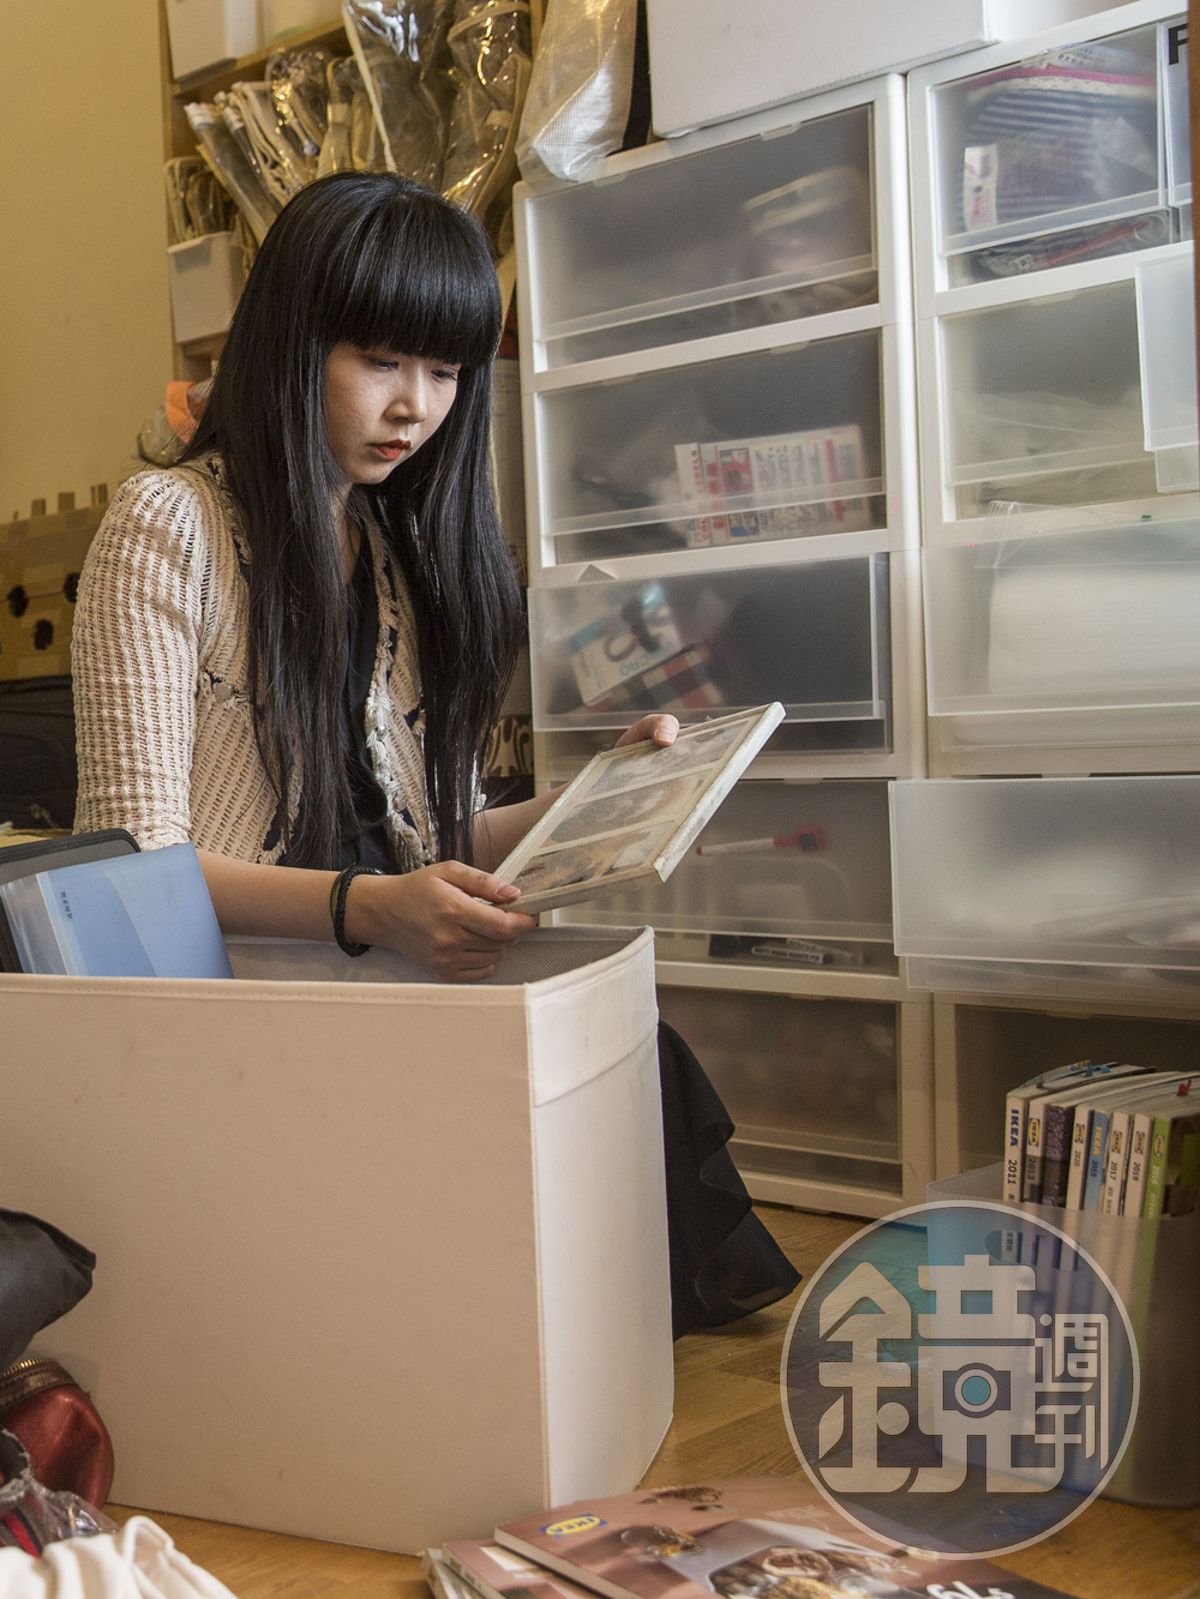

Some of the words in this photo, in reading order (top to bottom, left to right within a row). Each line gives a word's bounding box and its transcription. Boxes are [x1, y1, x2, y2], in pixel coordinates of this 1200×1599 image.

[1009, 1108, 1020, 1147] IKEA
[1007, 1159, 1018, 1185] 2011
[1109, 1161, 1118, 1180] 2017
